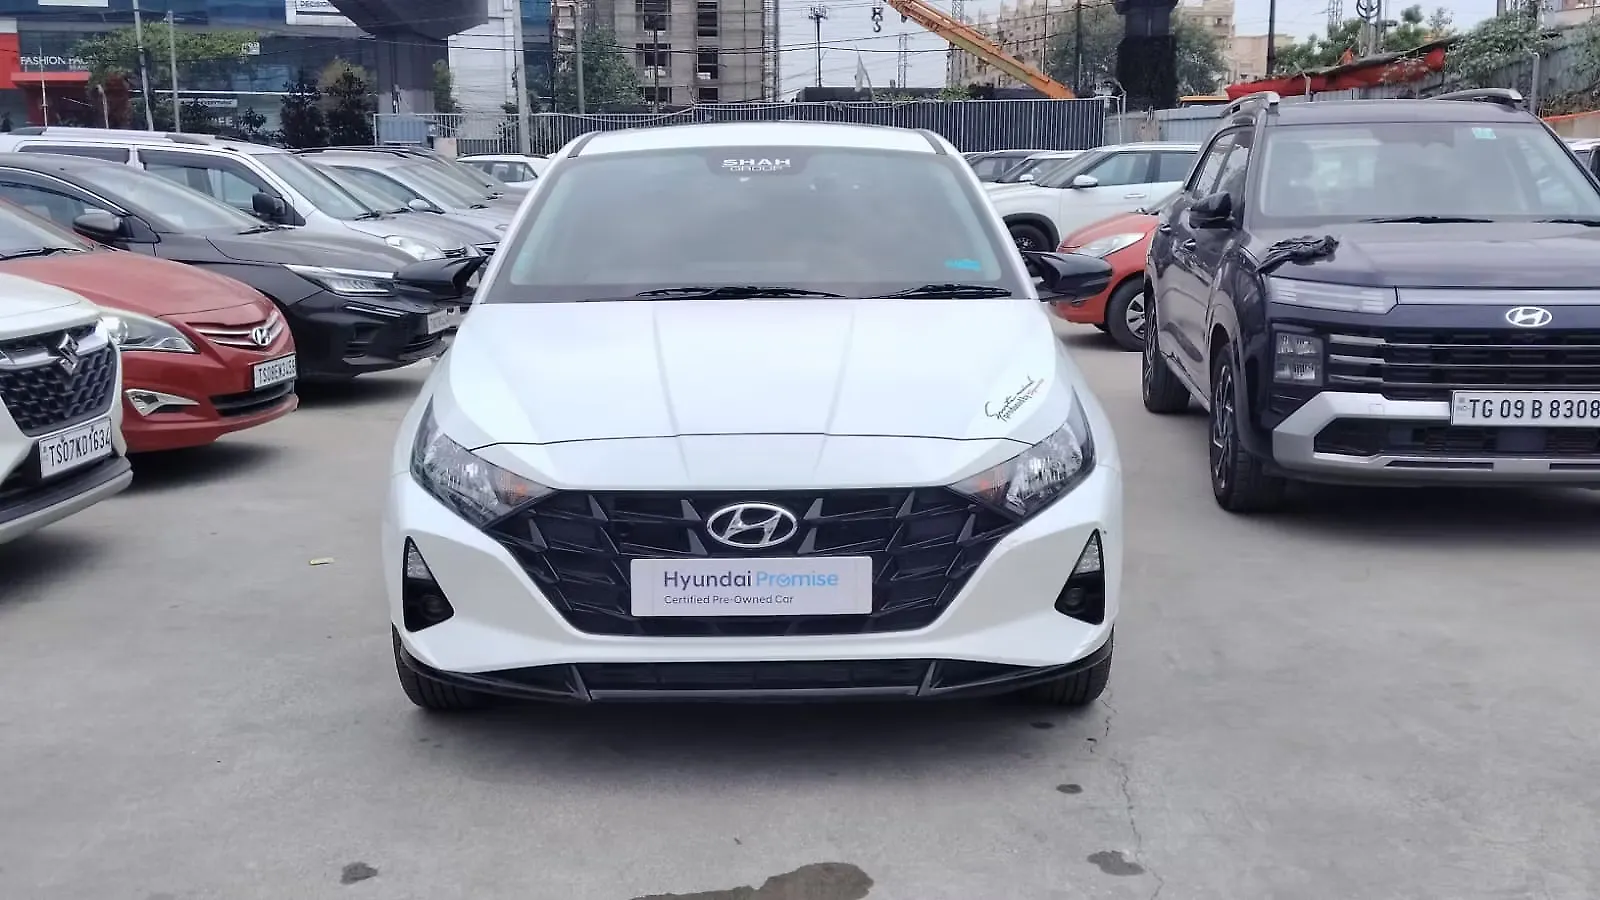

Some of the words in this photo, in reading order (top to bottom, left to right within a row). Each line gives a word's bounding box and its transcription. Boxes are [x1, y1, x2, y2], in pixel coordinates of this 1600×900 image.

[21, 56, 66, 65] FASHION
[722, 158, 791, 167] SHAH
[1469, 399, 1493, 418] TG
[1500, 399, 1524, 418] 09
[1531, 399, 1543, 418] B
[1549, 399, 1600, 418] 8308
[48, 426, 111, 467] TS07KD1634
[664, 570, 752, 590] Hyundai
[756, 571, 839, 587] Promise
[664, 595, 710, 604] Certified
[713, 595, 772, 604] Pre-Owned
[775, 594, 793, 604] Car
